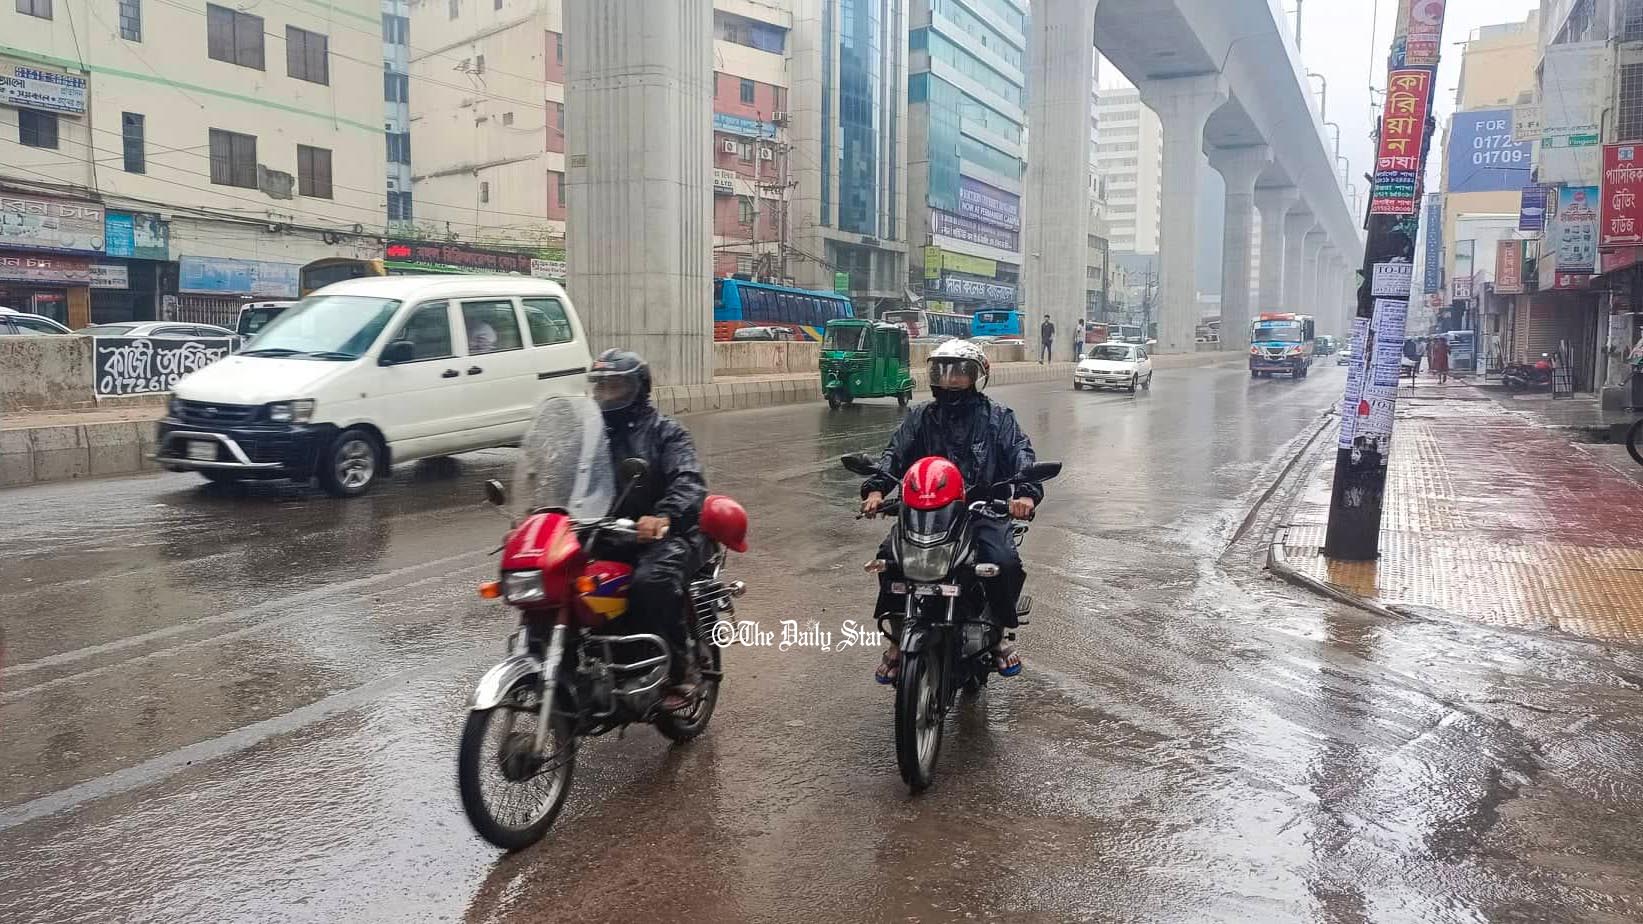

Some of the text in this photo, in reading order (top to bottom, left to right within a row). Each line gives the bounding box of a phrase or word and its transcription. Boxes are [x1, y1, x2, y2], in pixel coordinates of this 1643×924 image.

[1475, 120, 1506, 131] FOR
[1473, 134, 1523, 149] 0172
[99, 339, 154, 379] কাজী
[100, 373, 191, 393] 0172619
